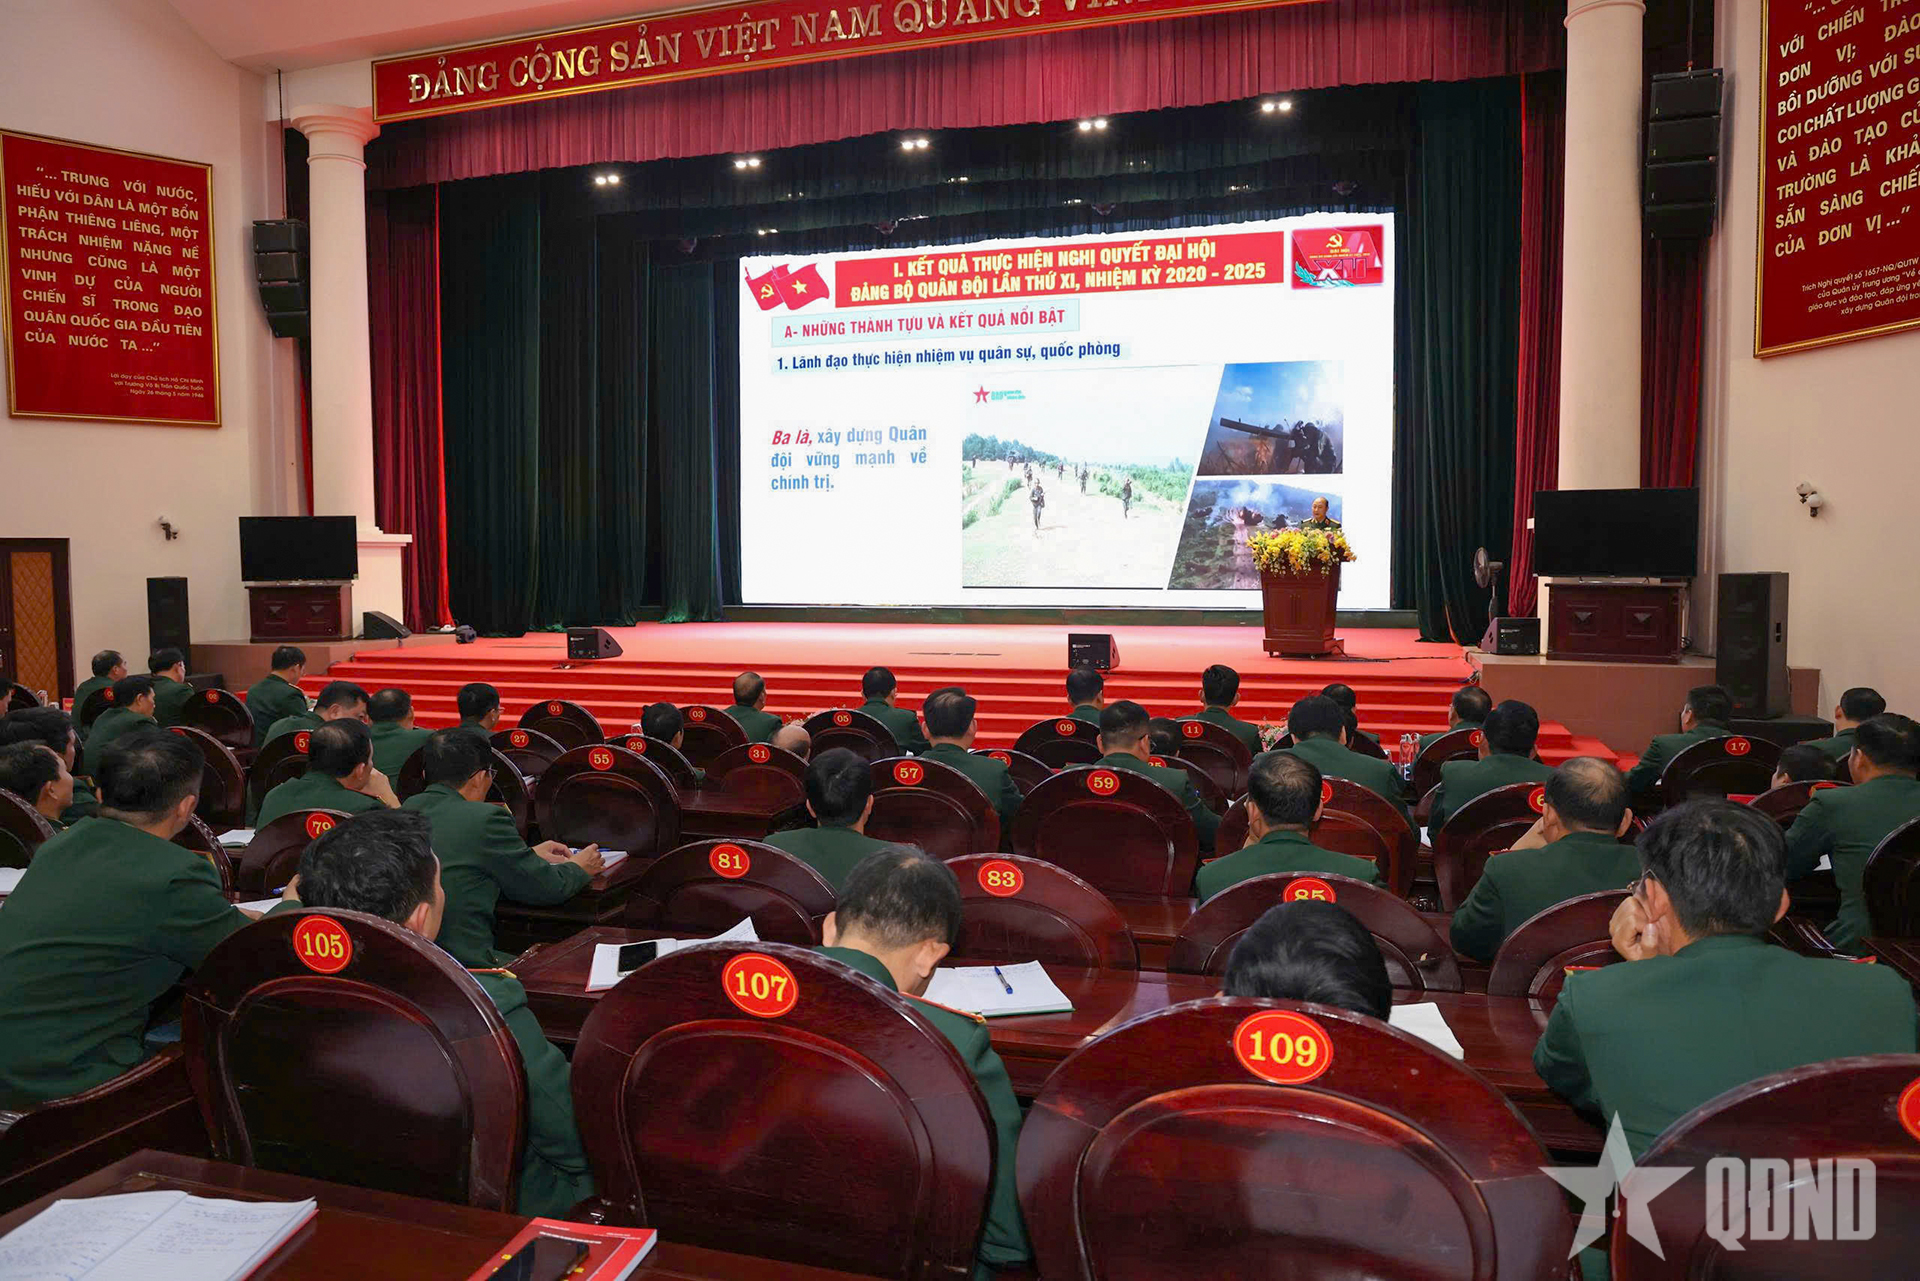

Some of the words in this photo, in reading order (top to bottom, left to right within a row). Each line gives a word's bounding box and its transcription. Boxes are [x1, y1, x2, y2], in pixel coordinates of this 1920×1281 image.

[1780, 33, 1805, 58] VỚI
[1817, 6, 1865, 41] CHIẾN
[408, 57, 500, 103] ĐẢNG
[509, 44, 600, 90] CỘNG
[609, 24, 682, 72] SẢN
[694, 12, 780, 61] VIỆT
[791, 10, 882, 46] NAM
[1779, 60, 1812, 88] ĐƠN
[1836, 43, 1857, 63] VỊ;
[1777, 90, 1802, 117] BỒI
[1806, 69, 1863, 105] DƯỠNG
[1869, 52, 1898, 79] VỚI
[1777, 123, 1802, 144] COI
[1804, 103, 1845, 134] CHẤT
[1847, 83, 1904, 120] LƯỢNG
[1777, 150, 1798, 172] VÀ
[1809, 138, 1842, 161] ĐÀO
[1854, 121, 1888, 146] TẠO
[1777, 168, 1837, 200] TRƯỜNG
[1850, 154, 1871, 177] LÀ
[1885, 134, 1920, 165] KHẢ
[61, 171, 109, 188] TRUNG
[123, 180, 146, 194] VỚI
[156, 186, 197, 203] NƯỚC,
[17, 183, 50, 199] HIẾU
[55, 189, 79, 204] VỚI
[84, 194, 113, 209] DÂN
[118, 199, 135, 212] LÀ
[139, 202, 167, 218] MỘT
[172, 204, 199, 221] BỔN
[1775, 203, 1806, 229] SẴN
[1819, 190, 1864, 216] SÀNG
[18, 205, 59, 223] PHẬN
[65, 212, 116, 229] THIÊNG
[122, 219, 164, 237] LIÊNG,
[171, 226, 199, 241] MỘT
[1775, 234, 1806, 257] CỦA
[1818, 223, 1852, 246] ĐƠN
[1866, 214, 1882, 234] VỊ
[19, 227, 67, 243] TRÁCH
[79, 234, 122, 251] NHIỆM
[133, 240, 172, 256] NẶNG
[182, 245, 199, 259] NỀ
[20, 247, 73, 264] NHƯNG
[88, 255, 128, 270] CŨNG
[141, 261, 158, 274] LÀ
[172, 265, 201, 280] MỘT
[893, 261, 904, 278] I.
[907, 254, 934, 277] KẾT
[938, 253, 969, 276] QUẢ
[972, 253, 1013, 275] THỰC
[1017, 249, 1054, 272] HIỆN
[1058, 248, 1096, 269] NGHỊ
[1100, 240, 1151, 266] QUYẾT
[1154, 242, 1183, 264] ĐẠI
[1187, 238, 1217, 262] HỘI
[1314, 257, 1367, 281] XII
[21, 268, 57, 283] VINH
[74, 274, 96, 290] DỰ
[114, 276, 143, 292] CỦA
[160, 284, 202, 298] NGƯỜI
[850, 281, 890, 302] ĐẢNG
[893, 279, 914, 302] BỘ
[917, 277, 958, 299] QUÂN
[961, 274, 988, 298] ĐỘI
[992, 271, 1021, 293] LẦN
[1024, 270, 1057, 292] THỨ
[1060, 272, 1081, 291] XI,
[1085, 267, 1137, 290] NHIỆM
[1141, 264, 1162, 285] KỲ
[1165, 265, 1207, 284] 2020
[1223, 261, 1266, 281] 2025
[1862, 279, 1881, 289] Trung
[22, 288, 66, 304] CHIẾN
[82, 293, 97, 307] SĨ
[113, 298, 159, 313] TRONG
[174, 305, 203, 319] ĐẠO
[24, 310, 66, 325] QUÂN
[70, 313, 110, 329] QUỐC
[114, 319, 138, 331] GIA
[141, 319, 170, 334] ĐẦU
[173, 323, 203, 337] TIÊN
[784, 325, 799, 339] A-
[802, 319, 846, 338] NHỮNG
[850, 316, 893, 335] THÀNH
[897, 316, 924, 335] TỰU
[927, 313, 945, 330] VÀ
[949, 309, 974, 329] KẾT
[978, 308, 1006, 329] QUẢ
[1010, 305, 1034, 326] NỔI
[1039, 306, 1066, 327] BẬT
[25, 327, 56, 344] CỦA
[68, 334, 109, 348] NƯỚC
[120, 339, 138, 351] TA
[777, 357, 789, 370] 1.
[792, 355, 822, 370] Lãnh
[825, 354, 849, 370] đạo
[852, 352, 880, 369] thực
[884, 350, 912, 367] hiện
[916, 347, 955, 366] nhiệm
[959, 350, 975, 364] vụ
[978, 345, 1012, 363] quân
[1015, 345, 1036, 362] sự,
[1040, 340, 1074, 361] quốc
[1078, 340, 1121, 360] phòng
[771, 429, 791, 446] Ba
[795, 429, 813, 447] là,
[816, 427, 841, 446] xây
[846, 427, 883, 446] dựng
[888, 424, 928, 443] Quân
[771, 451, 793, 471] đội
[806, 449, 841, 470] vững
[855, 449, 896, 468] mạnh
[910, 445, 928, 465] về
[771, 472, 810, 491] chính
[813, 472, 835, 493] trị.
[550, 704, 560, 713] 01
[692, 709, 704, 719] 03
[837, 713, 849, 723] 05
[514, 735, 526, 744] 27
[1060, 722, 1073, 732] 09
[1187, 726, 1199, 734] 11
[594, 754, 610, 766] 55
[630, 742, 643, 751] 29
[753, 751, 766, 760] 31
[1731, 742, 1747, 751] 17
[900, 768, 919, 779] 57
[1094, 777, 1114, 789] 59
[718, 854, 743, 870] 81
[987, 870, 1017, 887] 83
[303, 932, 345, 958] 105
[734, 969, 788, 1002] 107
[1246, 1031, 1318, 1066] 109
